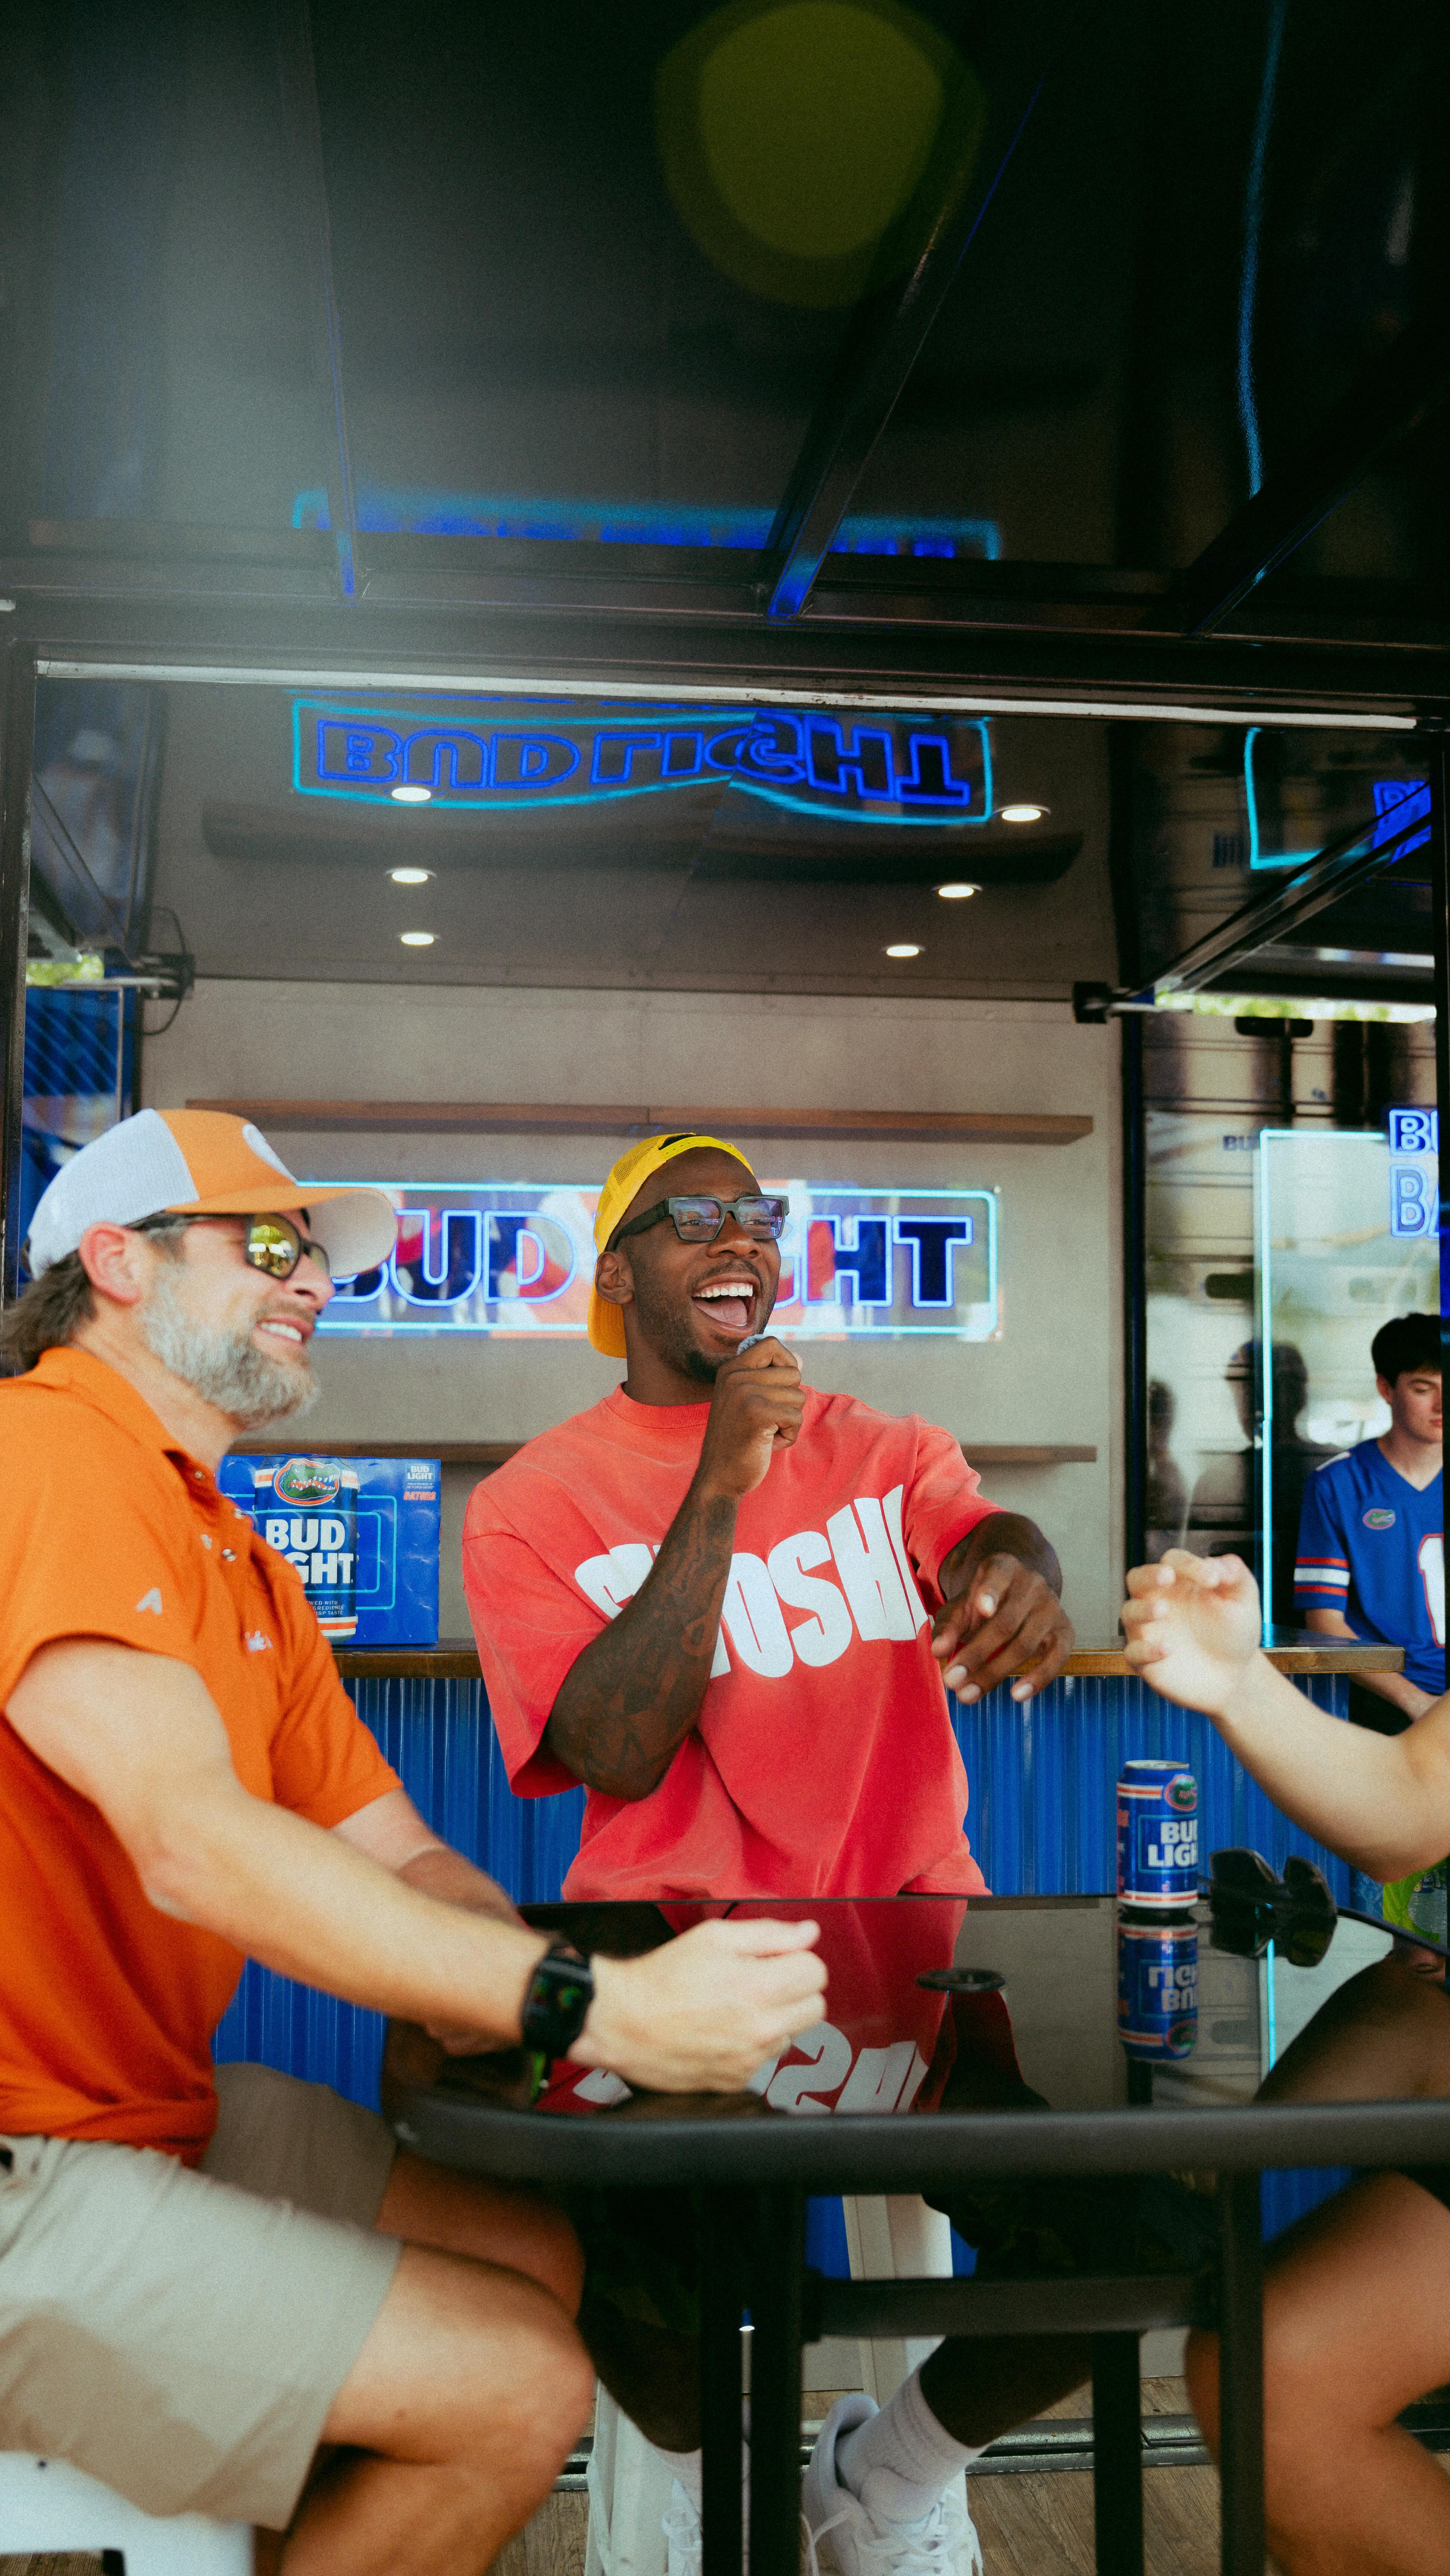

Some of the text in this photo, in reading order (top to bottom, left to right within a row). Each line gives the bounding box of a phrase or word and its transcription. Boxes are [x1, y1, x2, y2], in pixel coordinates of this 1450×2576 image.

[327, 1209, 579, 1307] UD
[403, 1491, 436, 1500] GATORS
[266, 1519, 345, 1550] BUD
[284, 1552, 354, 1584] GHT
[1148, 1842, 1198, 1868] LIG
